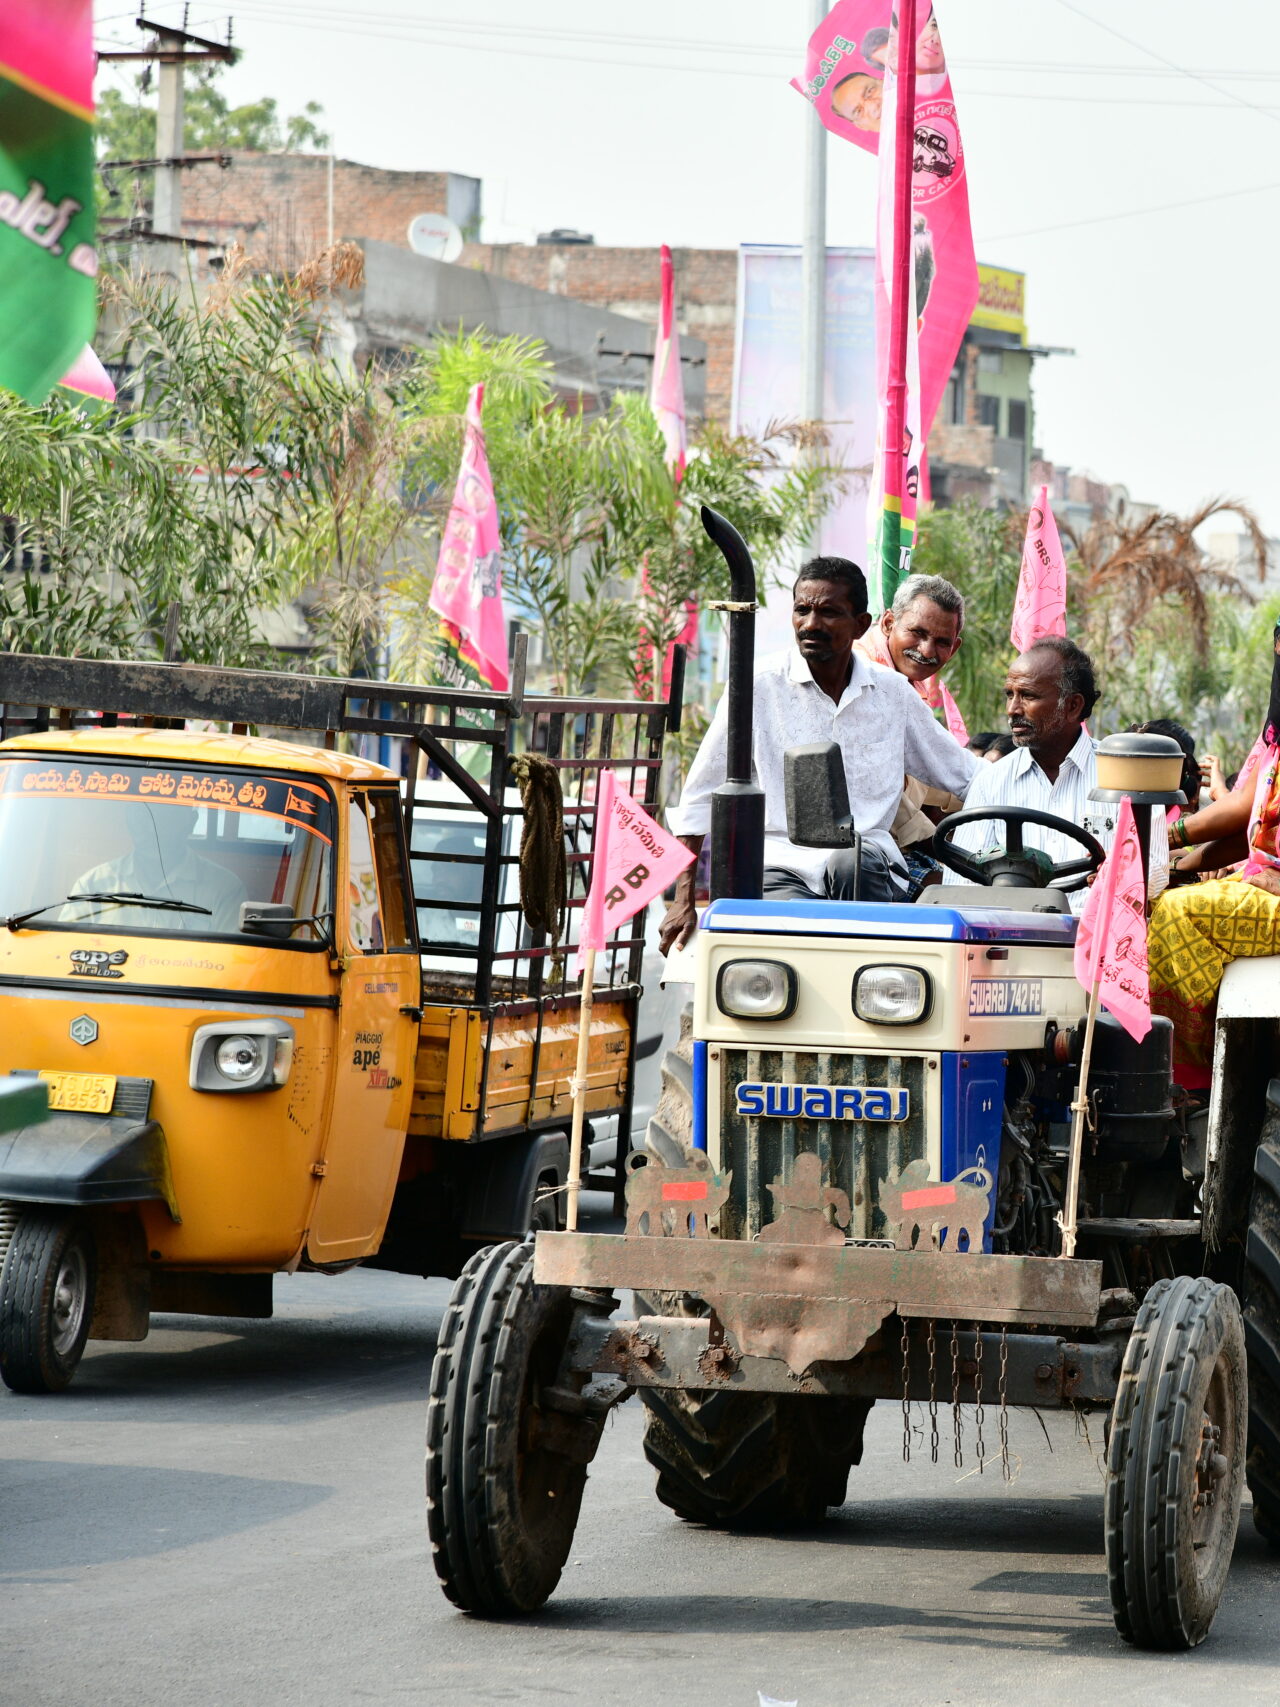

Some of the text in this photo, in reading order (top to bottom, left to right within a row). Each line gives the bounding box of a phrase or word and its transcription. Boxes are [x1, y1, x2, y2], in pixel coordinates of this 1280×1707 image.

[929, 176, 953, 195] CAR
[1033, 538, 1051, 567] BRS
[1009, 982, 1029, 1013] 742
[1029, 982, 1041, 1013] FE
[355, 1032, 383, 1044] PIAGGIO
[82, 1077, 105, 1094] 05
